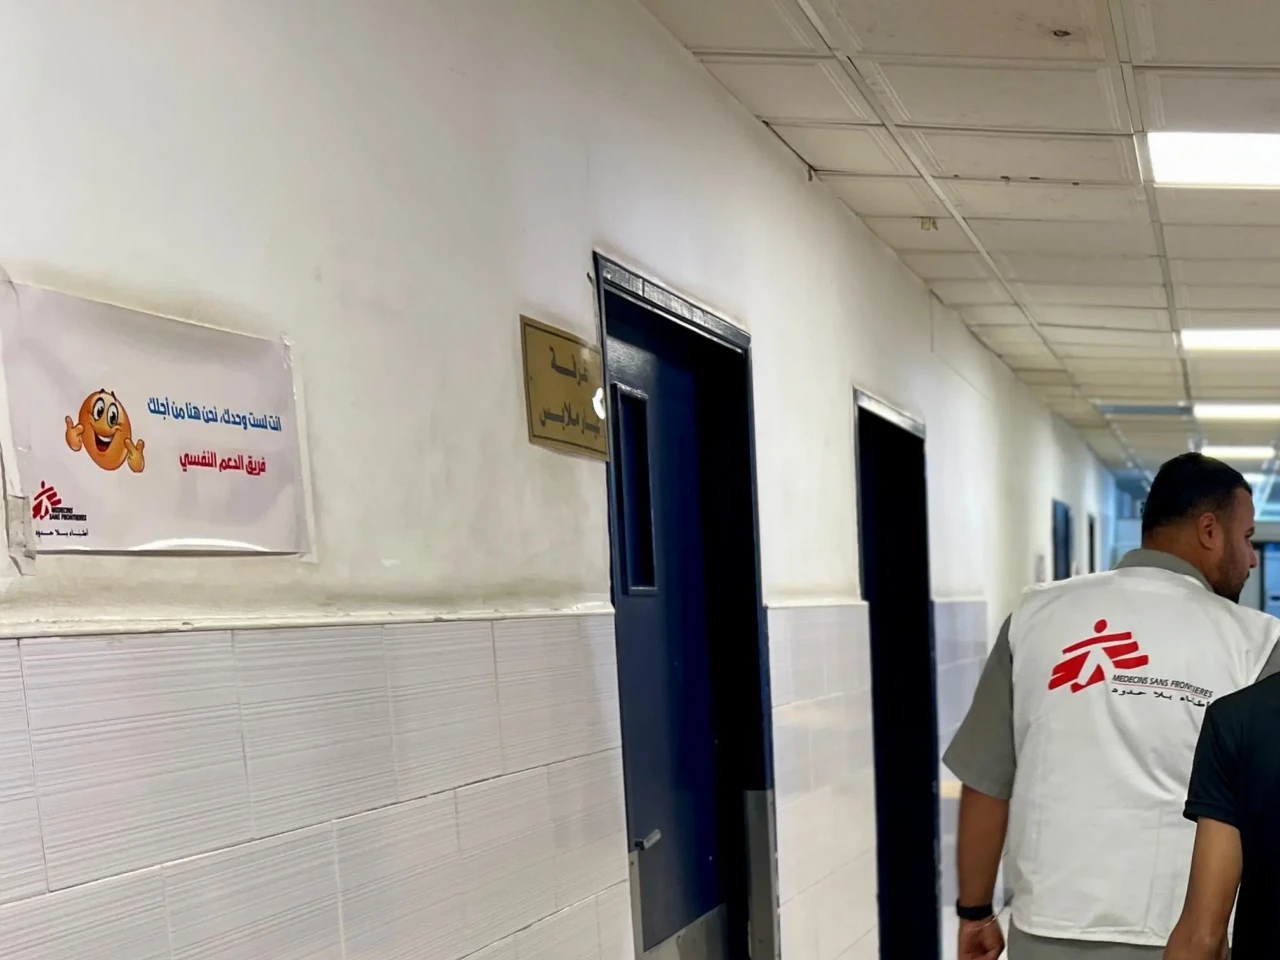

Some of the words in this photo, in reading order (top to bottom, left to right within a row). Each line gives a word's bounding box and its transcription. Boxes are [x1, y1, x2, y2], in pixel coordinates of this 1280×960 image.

[147, 397, 170, 420] أجلك
[171, 401, 185, 420] من
[185, 402, 201, 420] هنا
[203, 406, 218, 424] نحن
[248, 412, 268, 429] لست
[179, 450, 217, 472] النفسي
[219, 454, 244, 472] الدعم
[245, 456, 266, 476] فريق
[1111, 687, 1147, 696] حدود
[1112, 674, 1148, 685] MEDECINS
[1149, 677, 1169, 687] SANS
[1170, 680, 1214, 698] FRONTIERES
[1153, 691, 1173, 701] بلا
